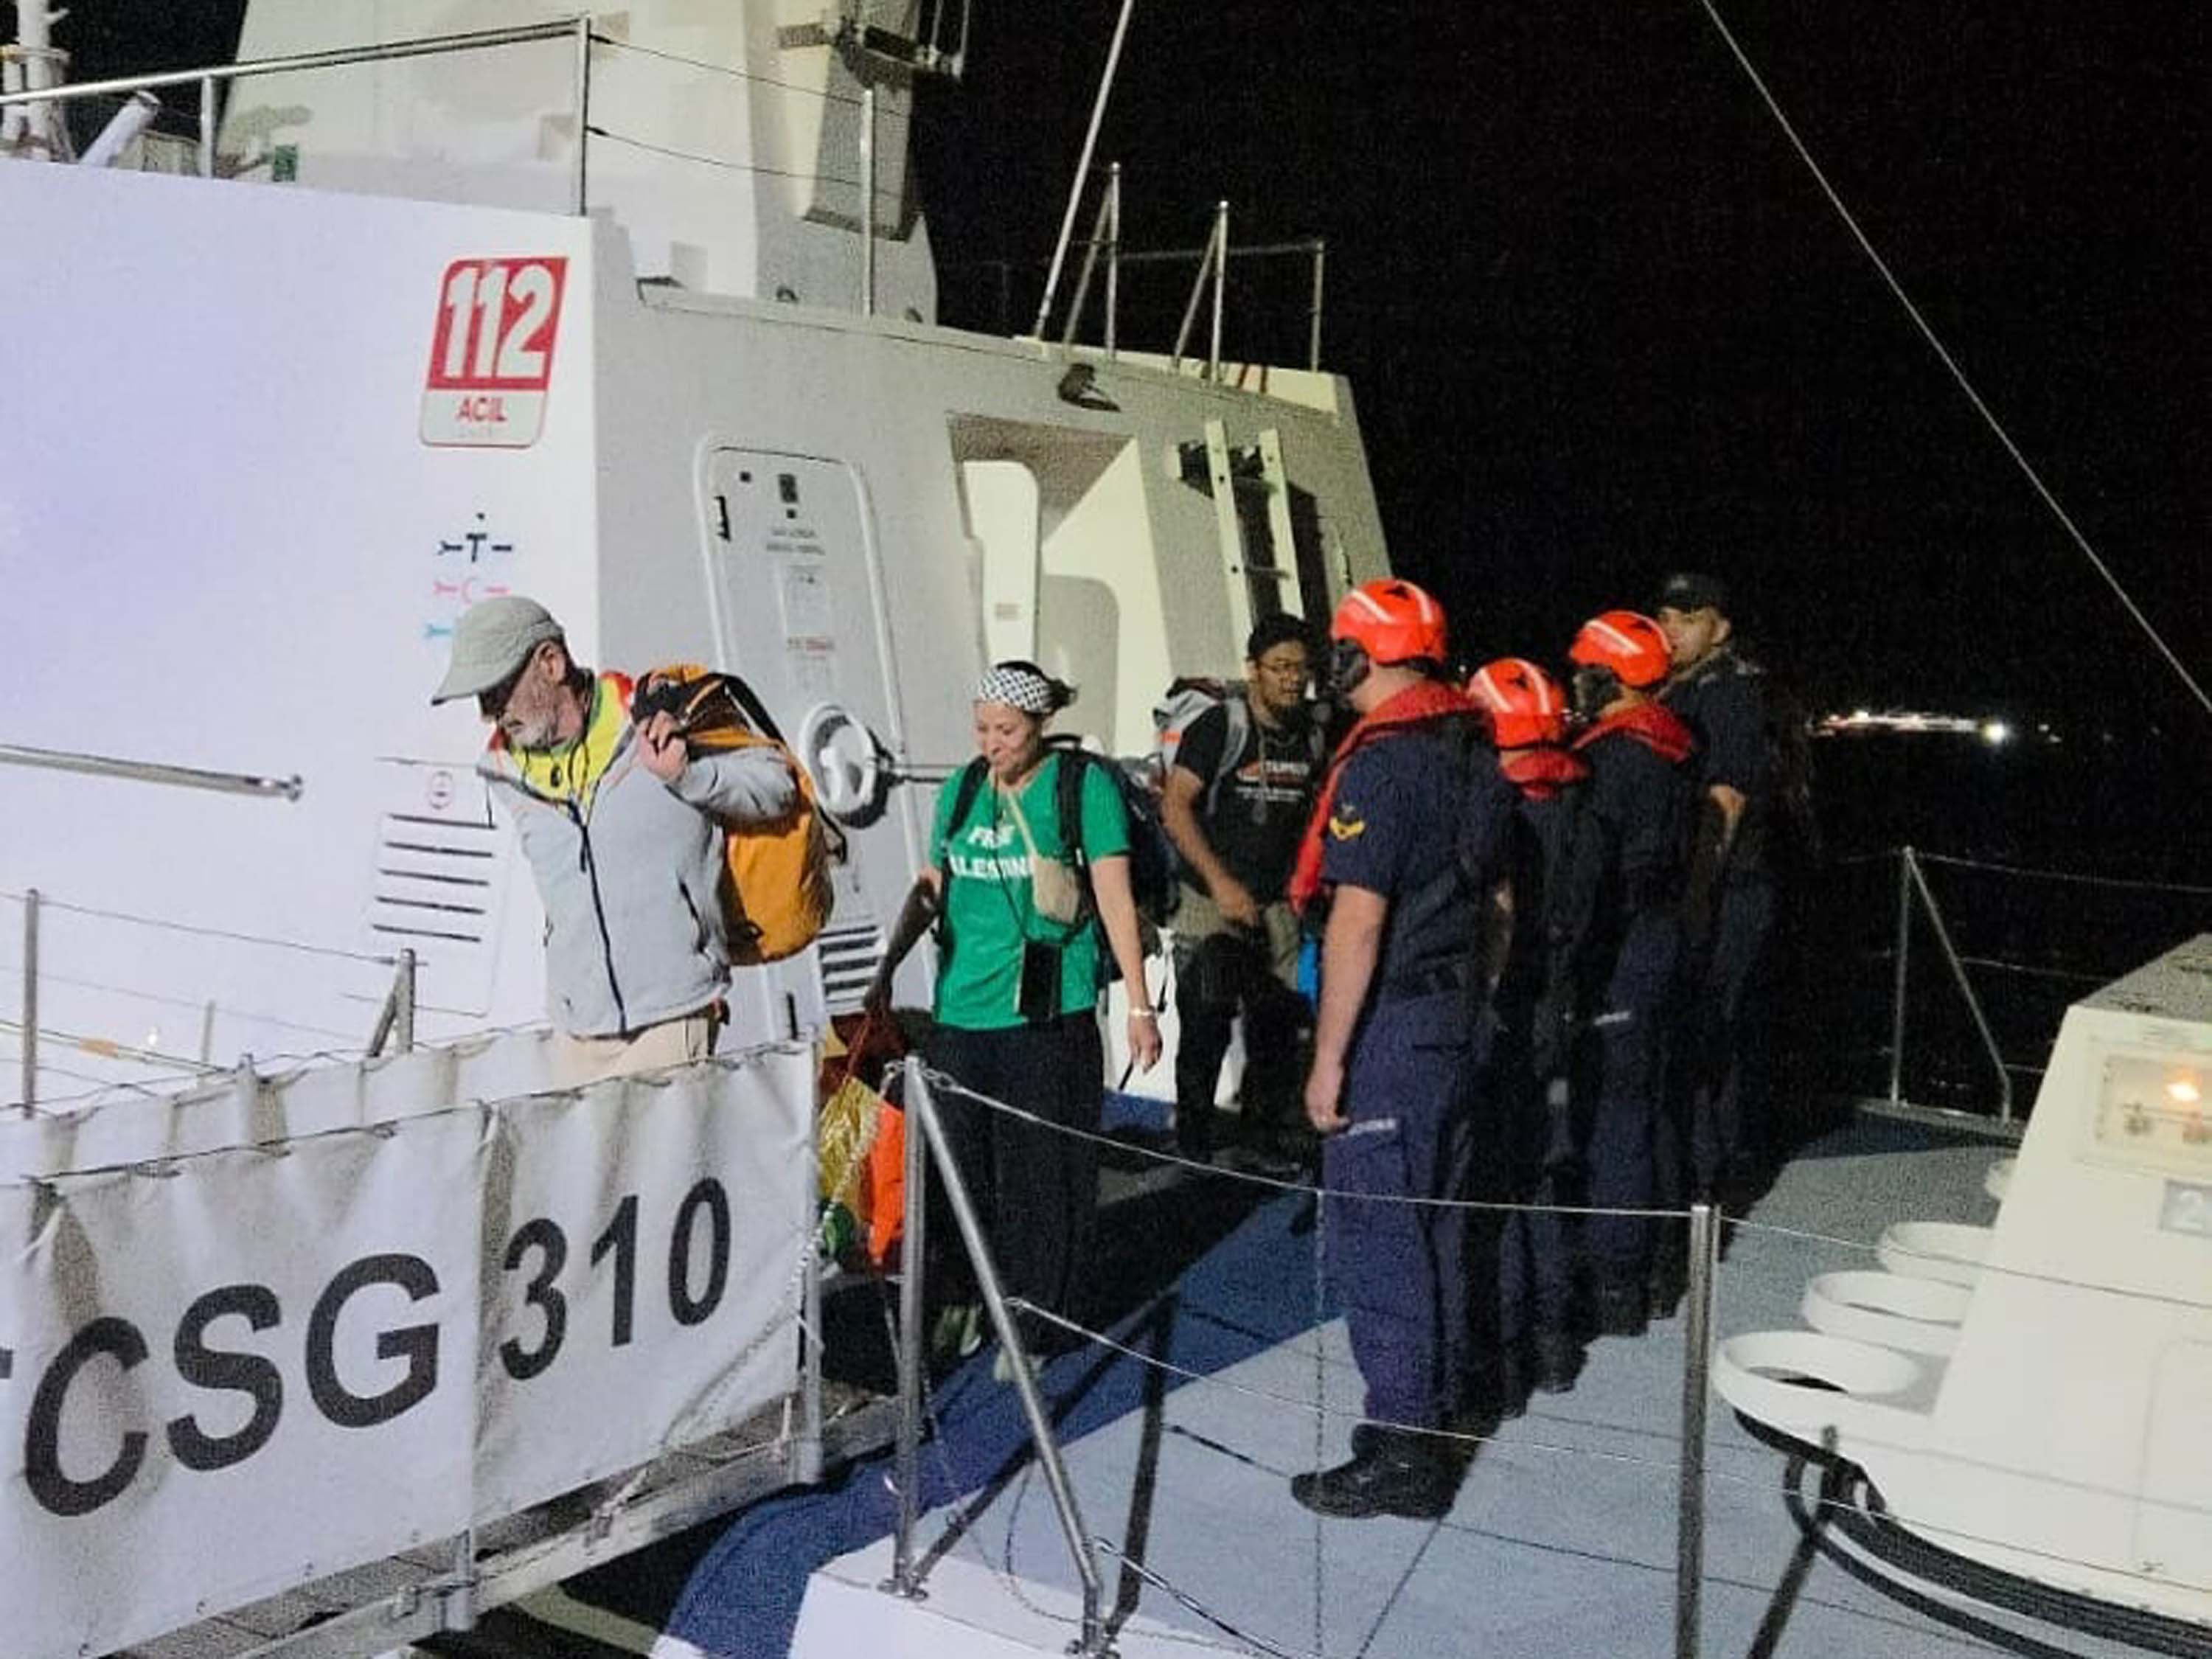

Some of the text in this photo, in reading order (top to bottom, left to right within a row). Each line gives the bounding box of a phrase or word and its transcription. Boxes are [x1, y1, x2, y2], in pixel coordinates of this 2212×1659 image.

[444, 265, 555, 378] 112
[0, 1176, 731, 1517] CSG 310
